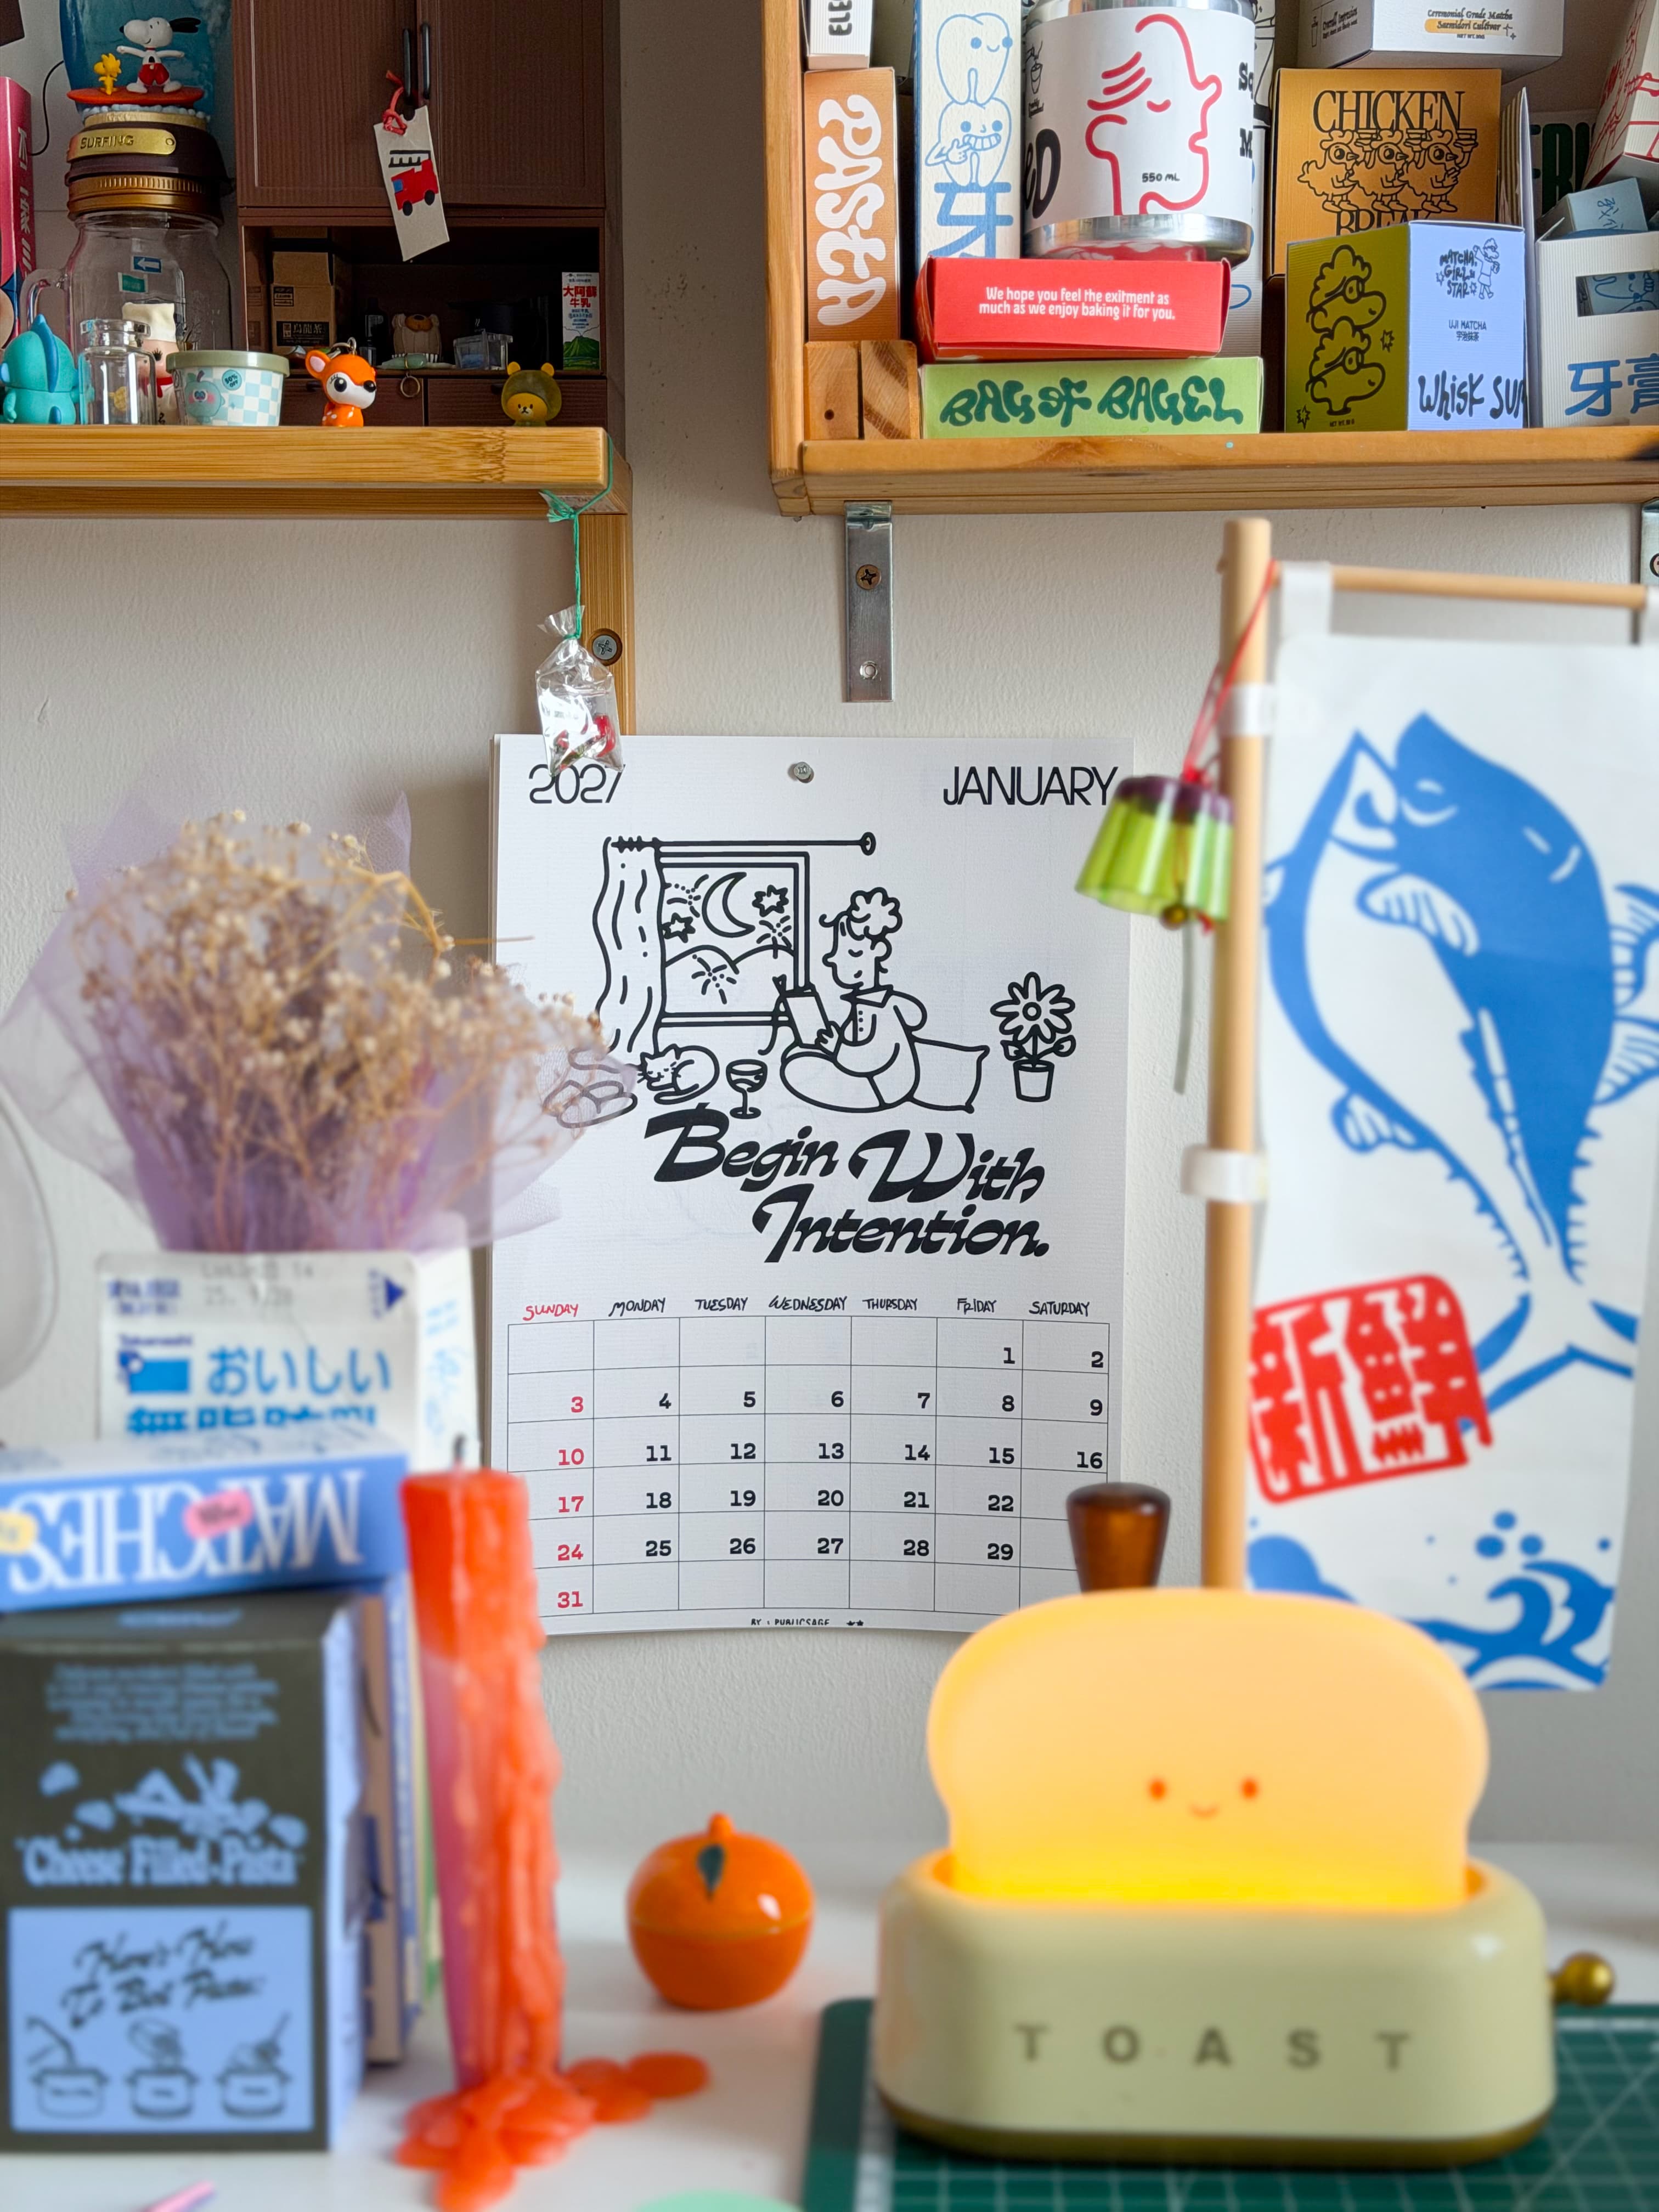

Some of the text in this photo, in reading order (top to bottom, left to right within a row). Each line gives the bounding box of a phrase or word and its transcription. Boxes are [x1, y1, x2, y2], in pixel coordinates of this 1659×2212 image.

[1427, 8, 1513, 20] Ceremonial Grade Matcha
[1313, 90, 1465, 134] CHICKEN
[1142, 172, 1163, 183] 550
[569, 297, 591, 308] 牛乳
[986, 286, 1170, 305] We hope you feel the exitment as
[1447, 279, 1470, 299] STAR
[979, 301, 1176, 322] much as we enjoy baking it for you.
[1448, 319, 1487, 331] UJI MATCHA
[939, 379, 1036, 427] BAG
[1098, 375, 1244, 426] BAGEL
[528, 763, 626, 805] 2027
[943, 766, 1119, 806] JANUARY
[644, 1102, 1045, 1204] Begin With
[752, 1183, 1050, 1263] Intention.
[522, 1295, 1090, 1322] SUNDAY MONDAY TUESDAY WEDNESDAY THURSDAY FRIDAY SATURDAY
[207, 1344, 390, 1396] おいしい
[1003, 1347, 1104, 1368] 1 2
[571, 1390, 1103, 1417] 3 4 5 6 7 8 9
[558, 1442, 1103, 1469] 10 11 12 13 14 15 16
[558, 1489, 1014, 1513] 17 18 19 20 21 22
[8, 1469, 364, 1594] MATCHES
[557, 1537, 1014, 1561] 24 25 26 27 28 29
[557, 1591, 583, 1609] 31
[1013, 2024, 1413, 2071] TOAST
